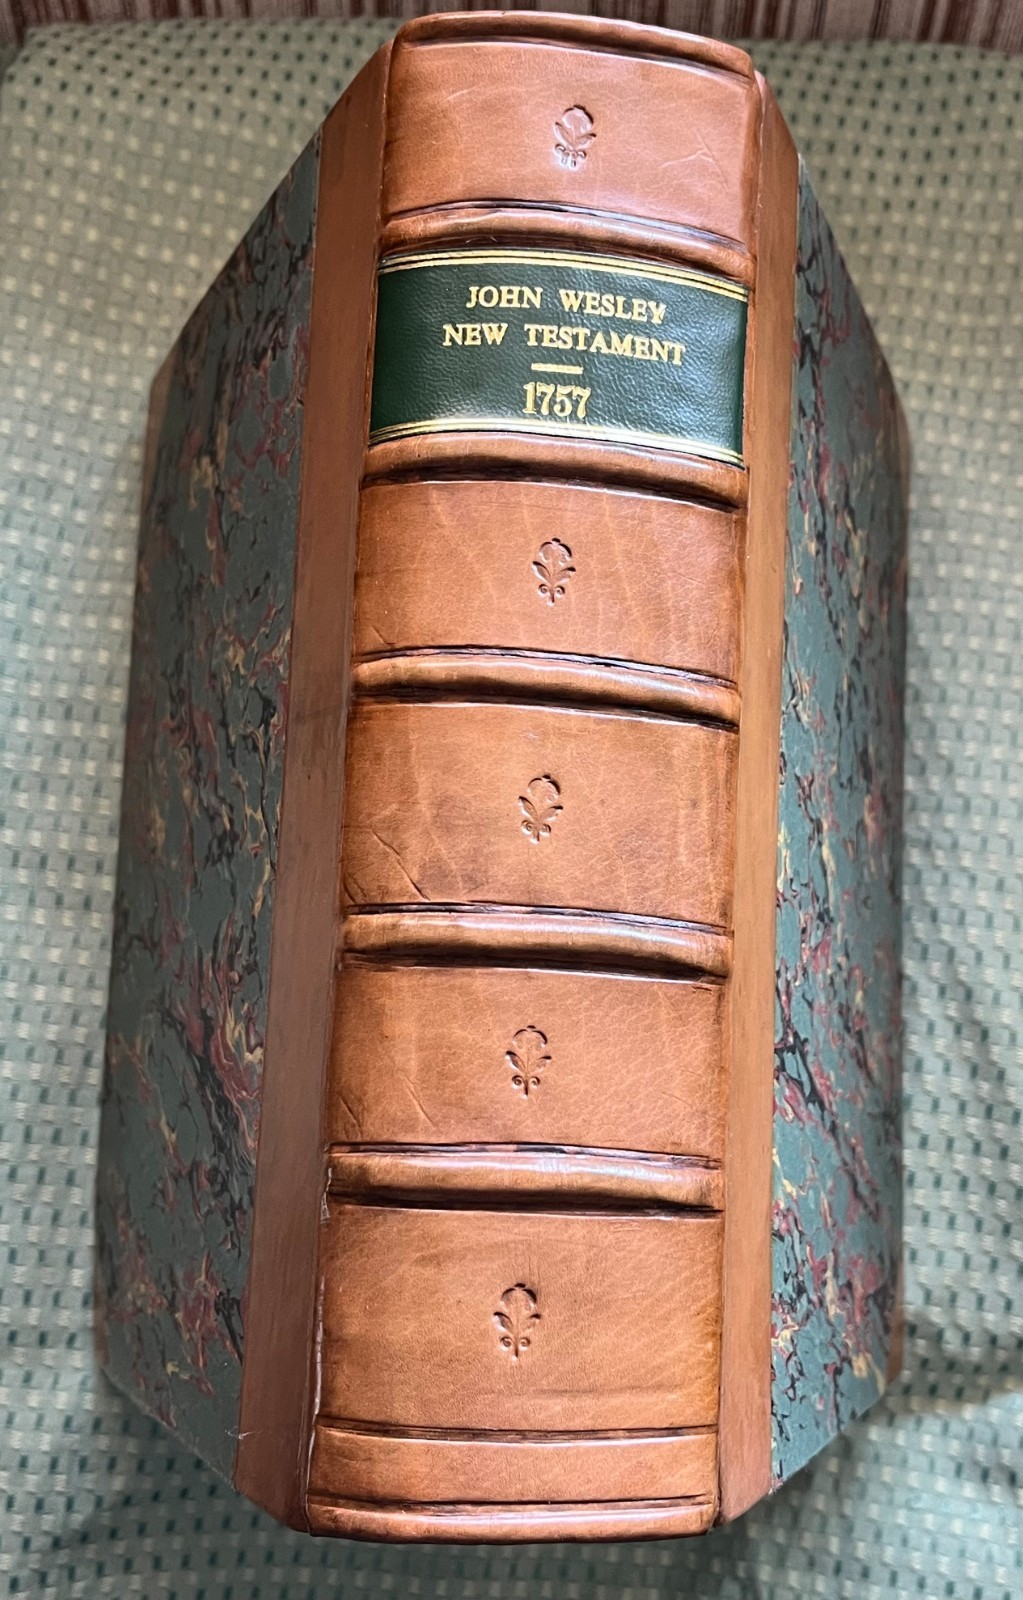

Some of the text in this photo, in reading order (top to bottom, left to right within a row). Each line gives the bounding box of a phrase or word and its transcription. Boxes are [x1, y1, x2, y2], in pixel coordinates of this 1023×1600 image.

[466, 286, 667, 325] JOHN WESLEY
[443, 323, 686, 366] NEW TESTAMENT
[522, 382, 591, 419] 1757
